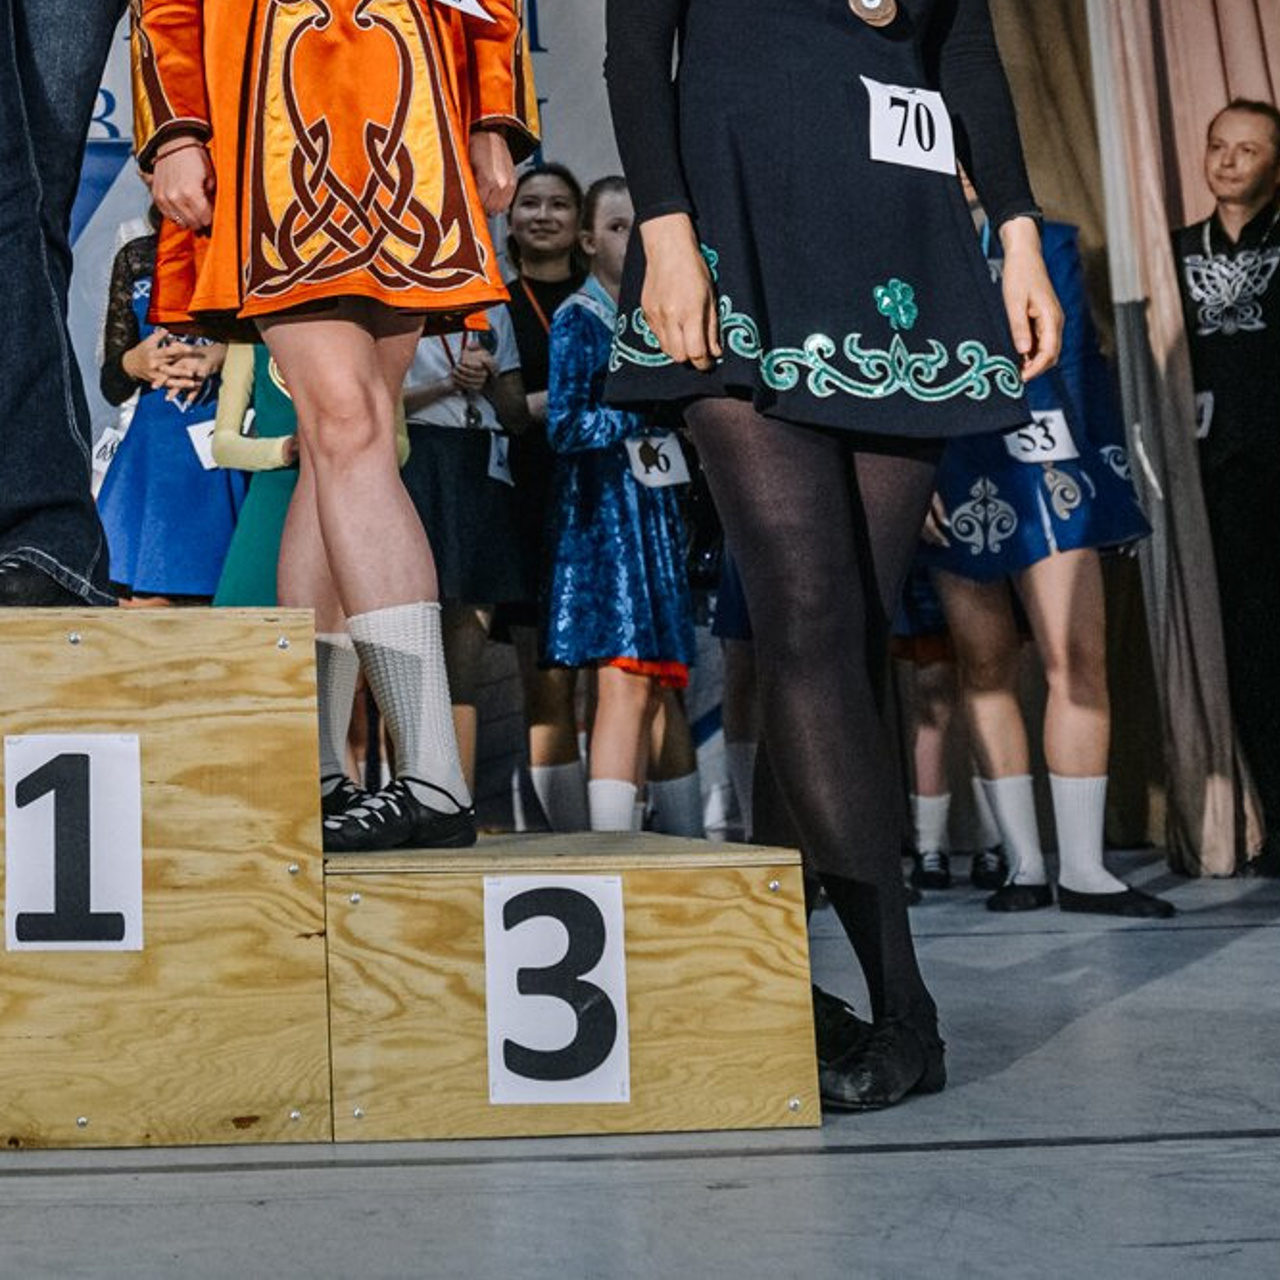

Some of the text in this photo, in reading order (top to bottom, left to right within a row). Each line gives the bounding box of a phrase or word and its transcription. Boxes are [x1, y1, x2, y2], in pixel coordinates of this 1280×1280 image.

[889, 96, 936, 152] 70
[15, 754, 125, 942] 1
[503, 887, 617, 1081] 3
